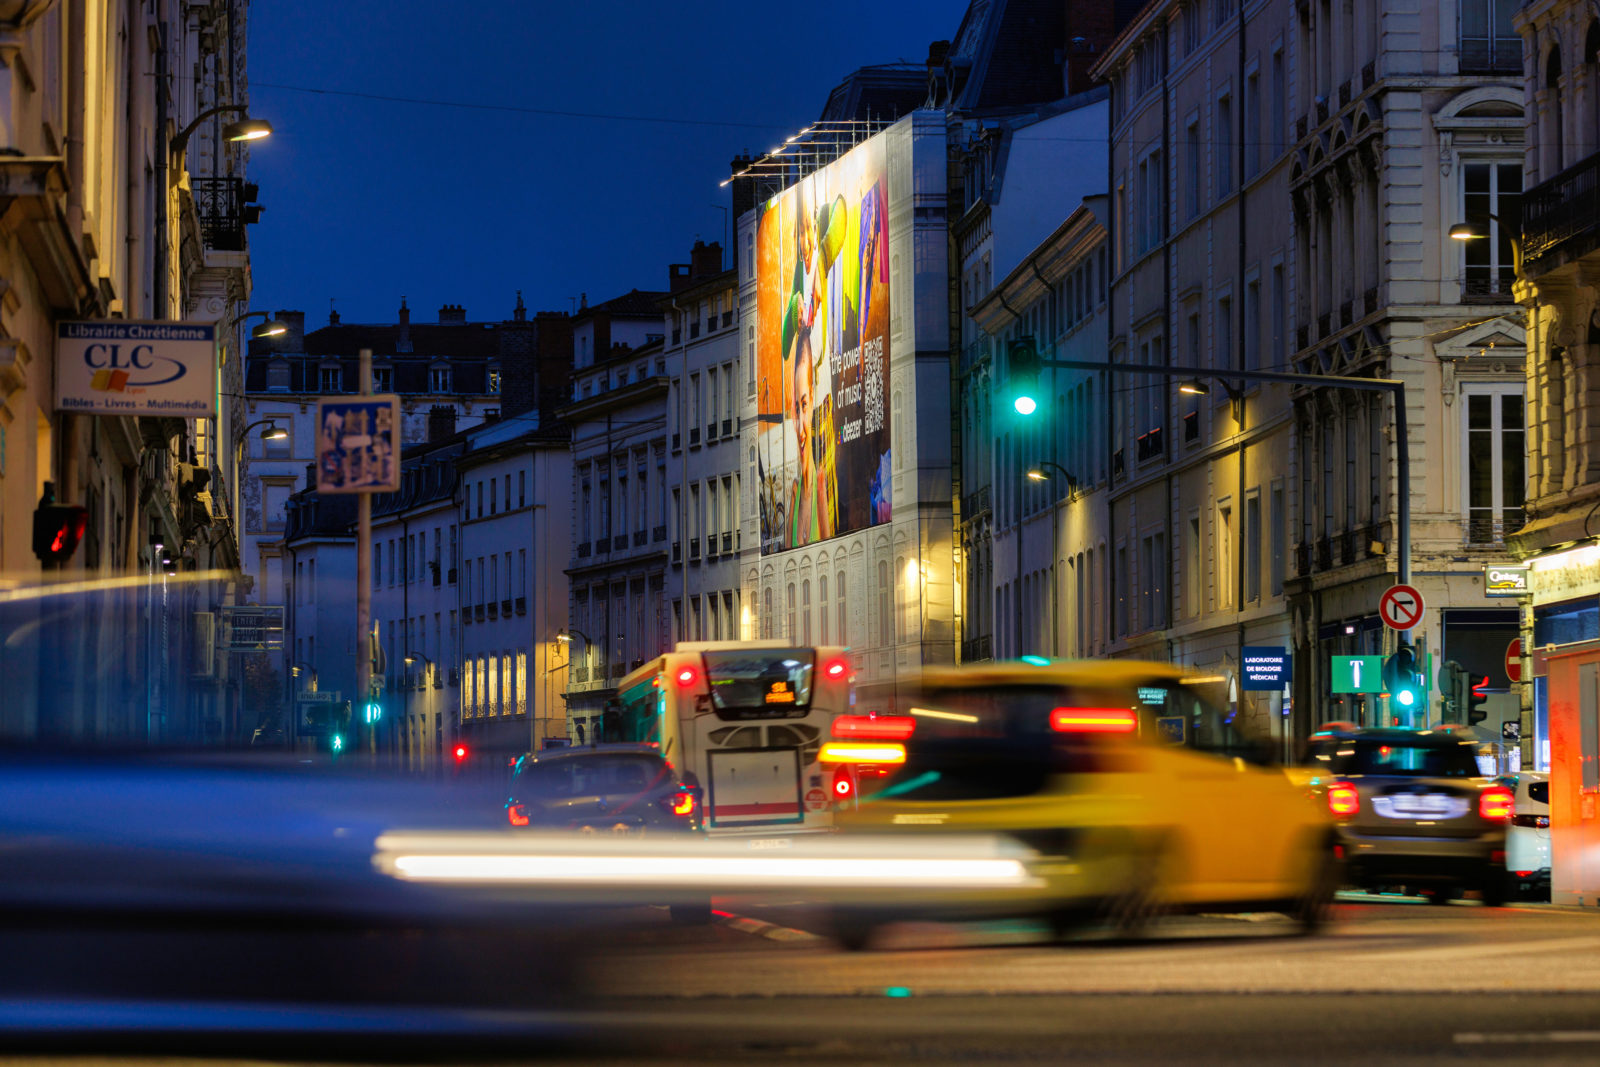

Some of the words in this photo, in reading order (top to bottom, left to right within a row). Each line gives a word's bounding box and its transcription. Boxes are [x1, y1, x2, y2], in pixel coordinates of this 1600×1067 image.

[67, 324, 125, 337] Librairie
[128, 325, 205, 339] Chrétienne
[84, 343, 154, 370] CLC
[831, 353, 842, 376] the
[843, 346, 862, 378] power
[62, 397, 94, 408] Bibles
[105, 398, 136, 408] Livres
[147, 398, 207, 410] Multimédia
[837, 381, 844, 409] of
[844, 376, 862, 407] music
[842, 416, 862, 443] deezer
[1350, 660, 1364, 688] T
